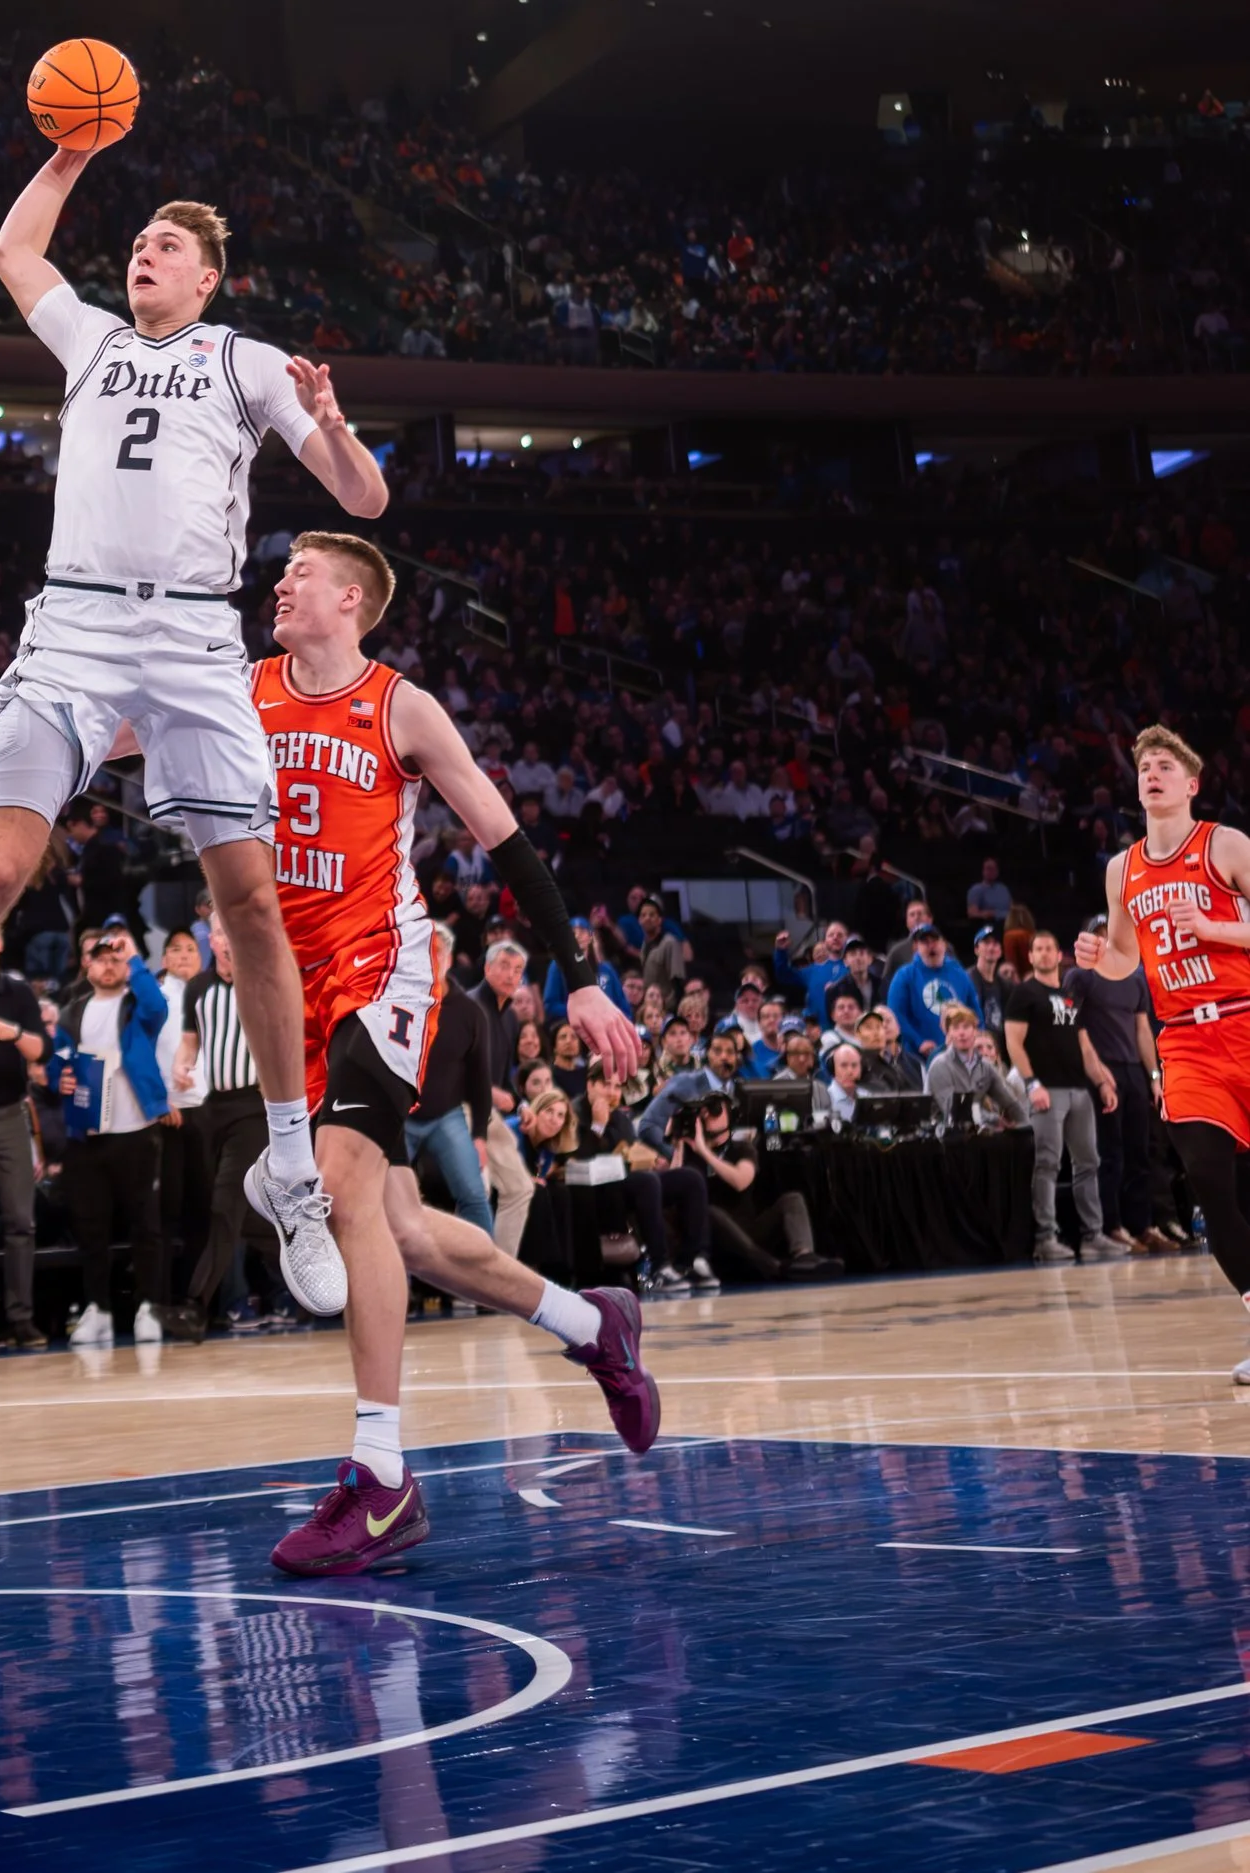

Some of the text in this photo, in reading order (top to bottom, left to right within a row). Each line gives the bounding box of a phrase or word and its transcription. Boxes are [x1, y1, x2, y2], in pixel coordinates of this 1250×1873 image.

[97, 359, 212, 402] Duke
[116, 407, 160, 471] 2
[265, 731, 379, 792] GHTING
[287, 782, 322, 837] 3
[275, 842, 346, 894] LLINI
[1127, 881, 1212, 927] FIGHTING
[1157, 954, 1216, 992] ILLINI
[1053, 1008, 1079, 1026] NY
